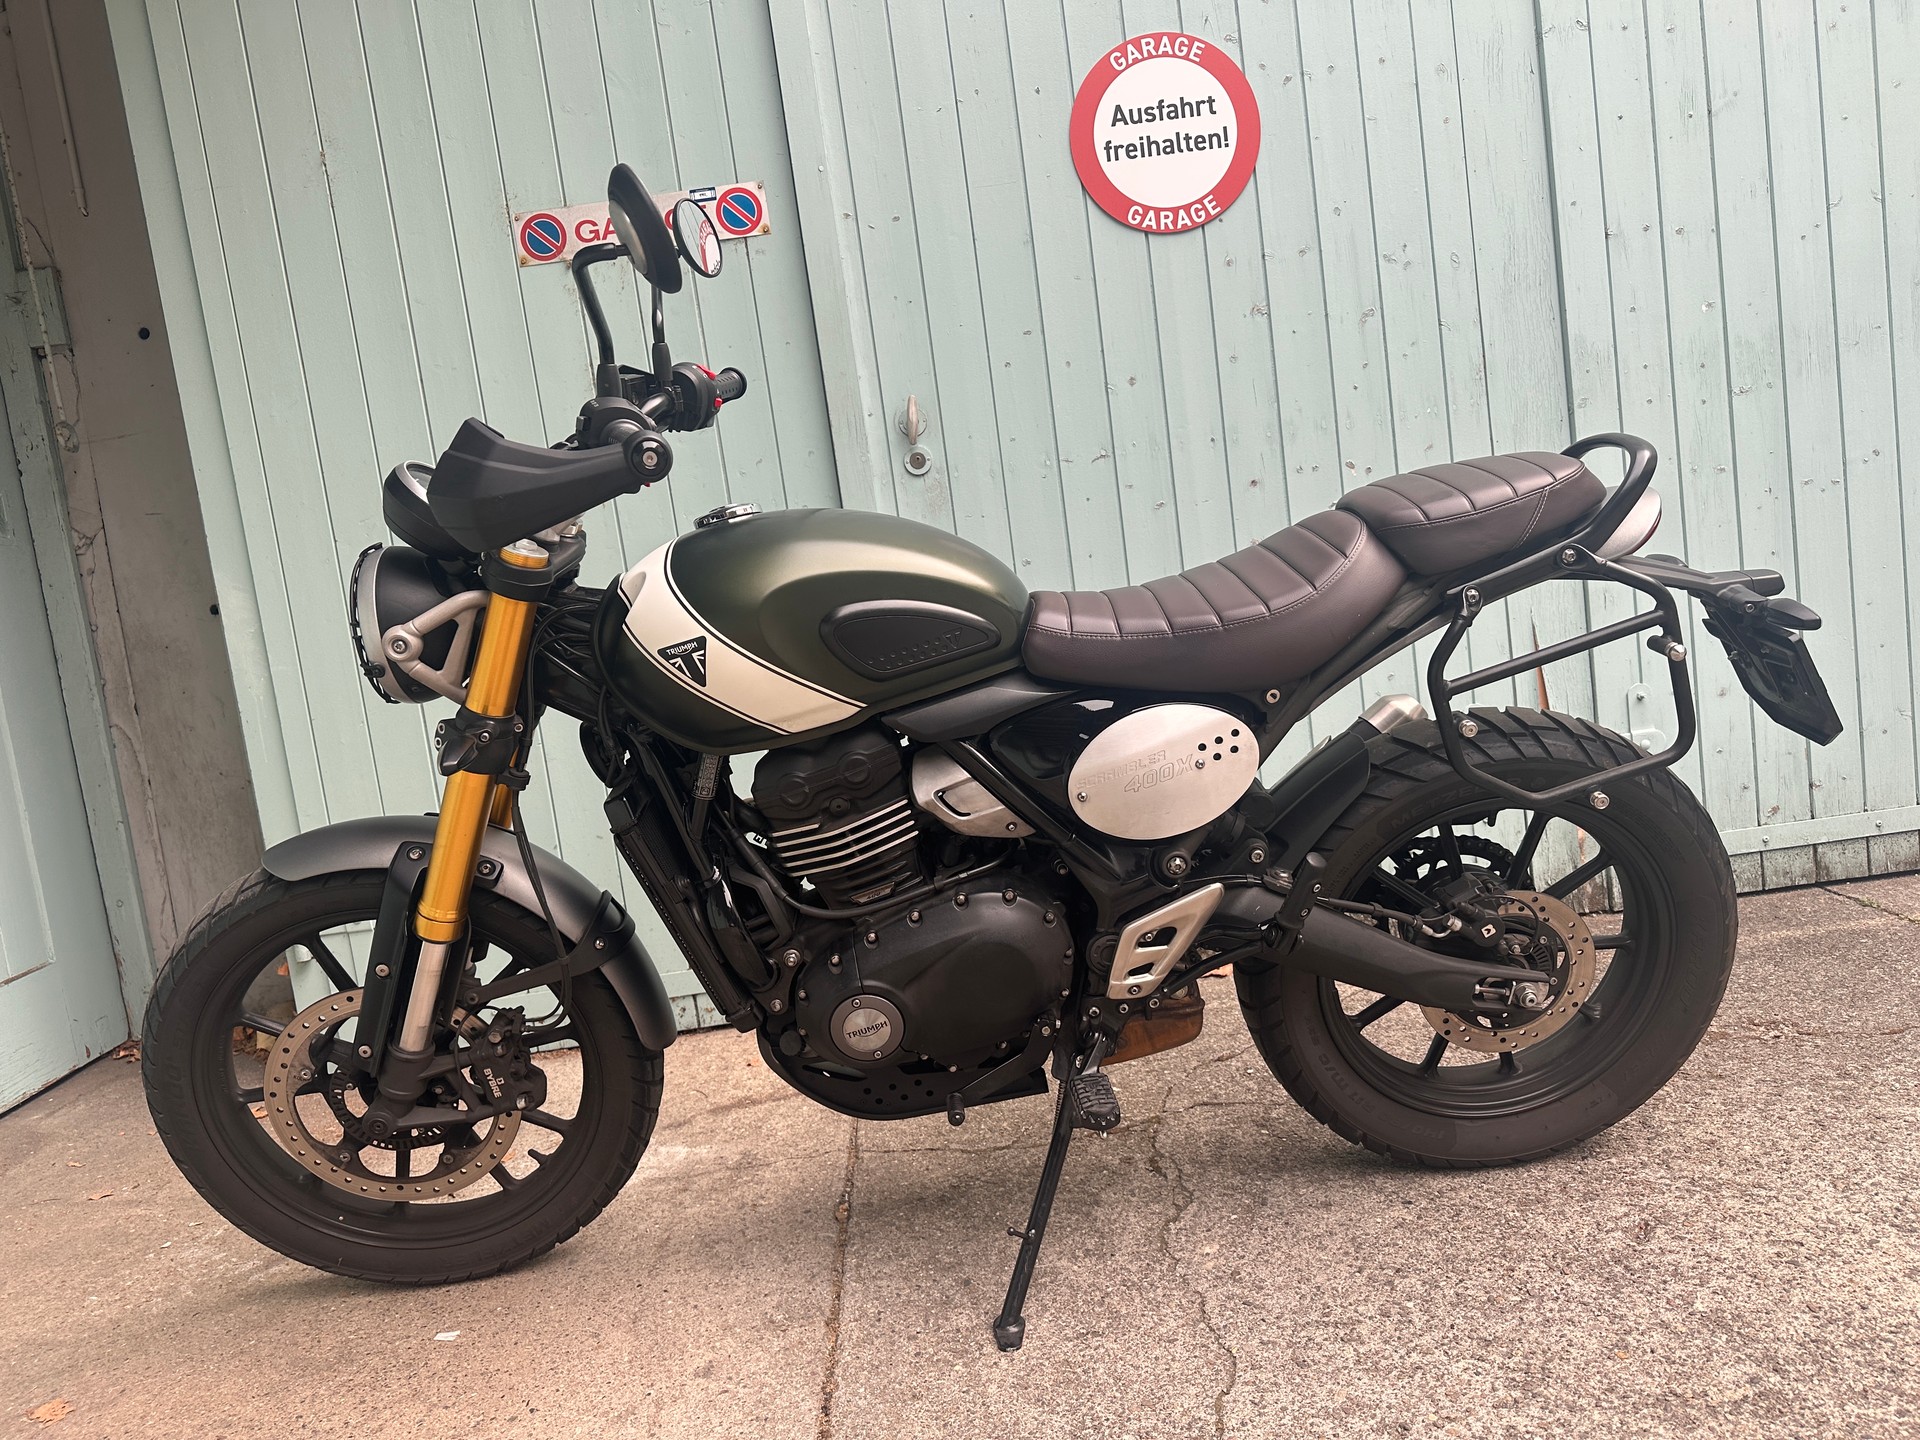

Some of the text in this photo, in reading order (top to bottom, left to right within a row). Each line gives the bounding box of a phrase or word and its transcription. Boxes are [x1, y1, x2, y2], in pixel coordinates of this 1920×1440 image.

[1109, 35, 1206, 71] GARAGE
[1110, 95, 1217, 128] Ausfahrt
[1103, 126, 1230, 162] freihalten!
[1127, 194, 1222, 231] GARAGE
[665, 641, 698, 656] TRIUMPH
[1075, 749, 1167, 790] SCRAMBLER
[1124, 753, 1194, 793] 400X
[846, 1020, 888, 1039] TRIUMPH
[483, 1068, 502, 1099] BYBRE
